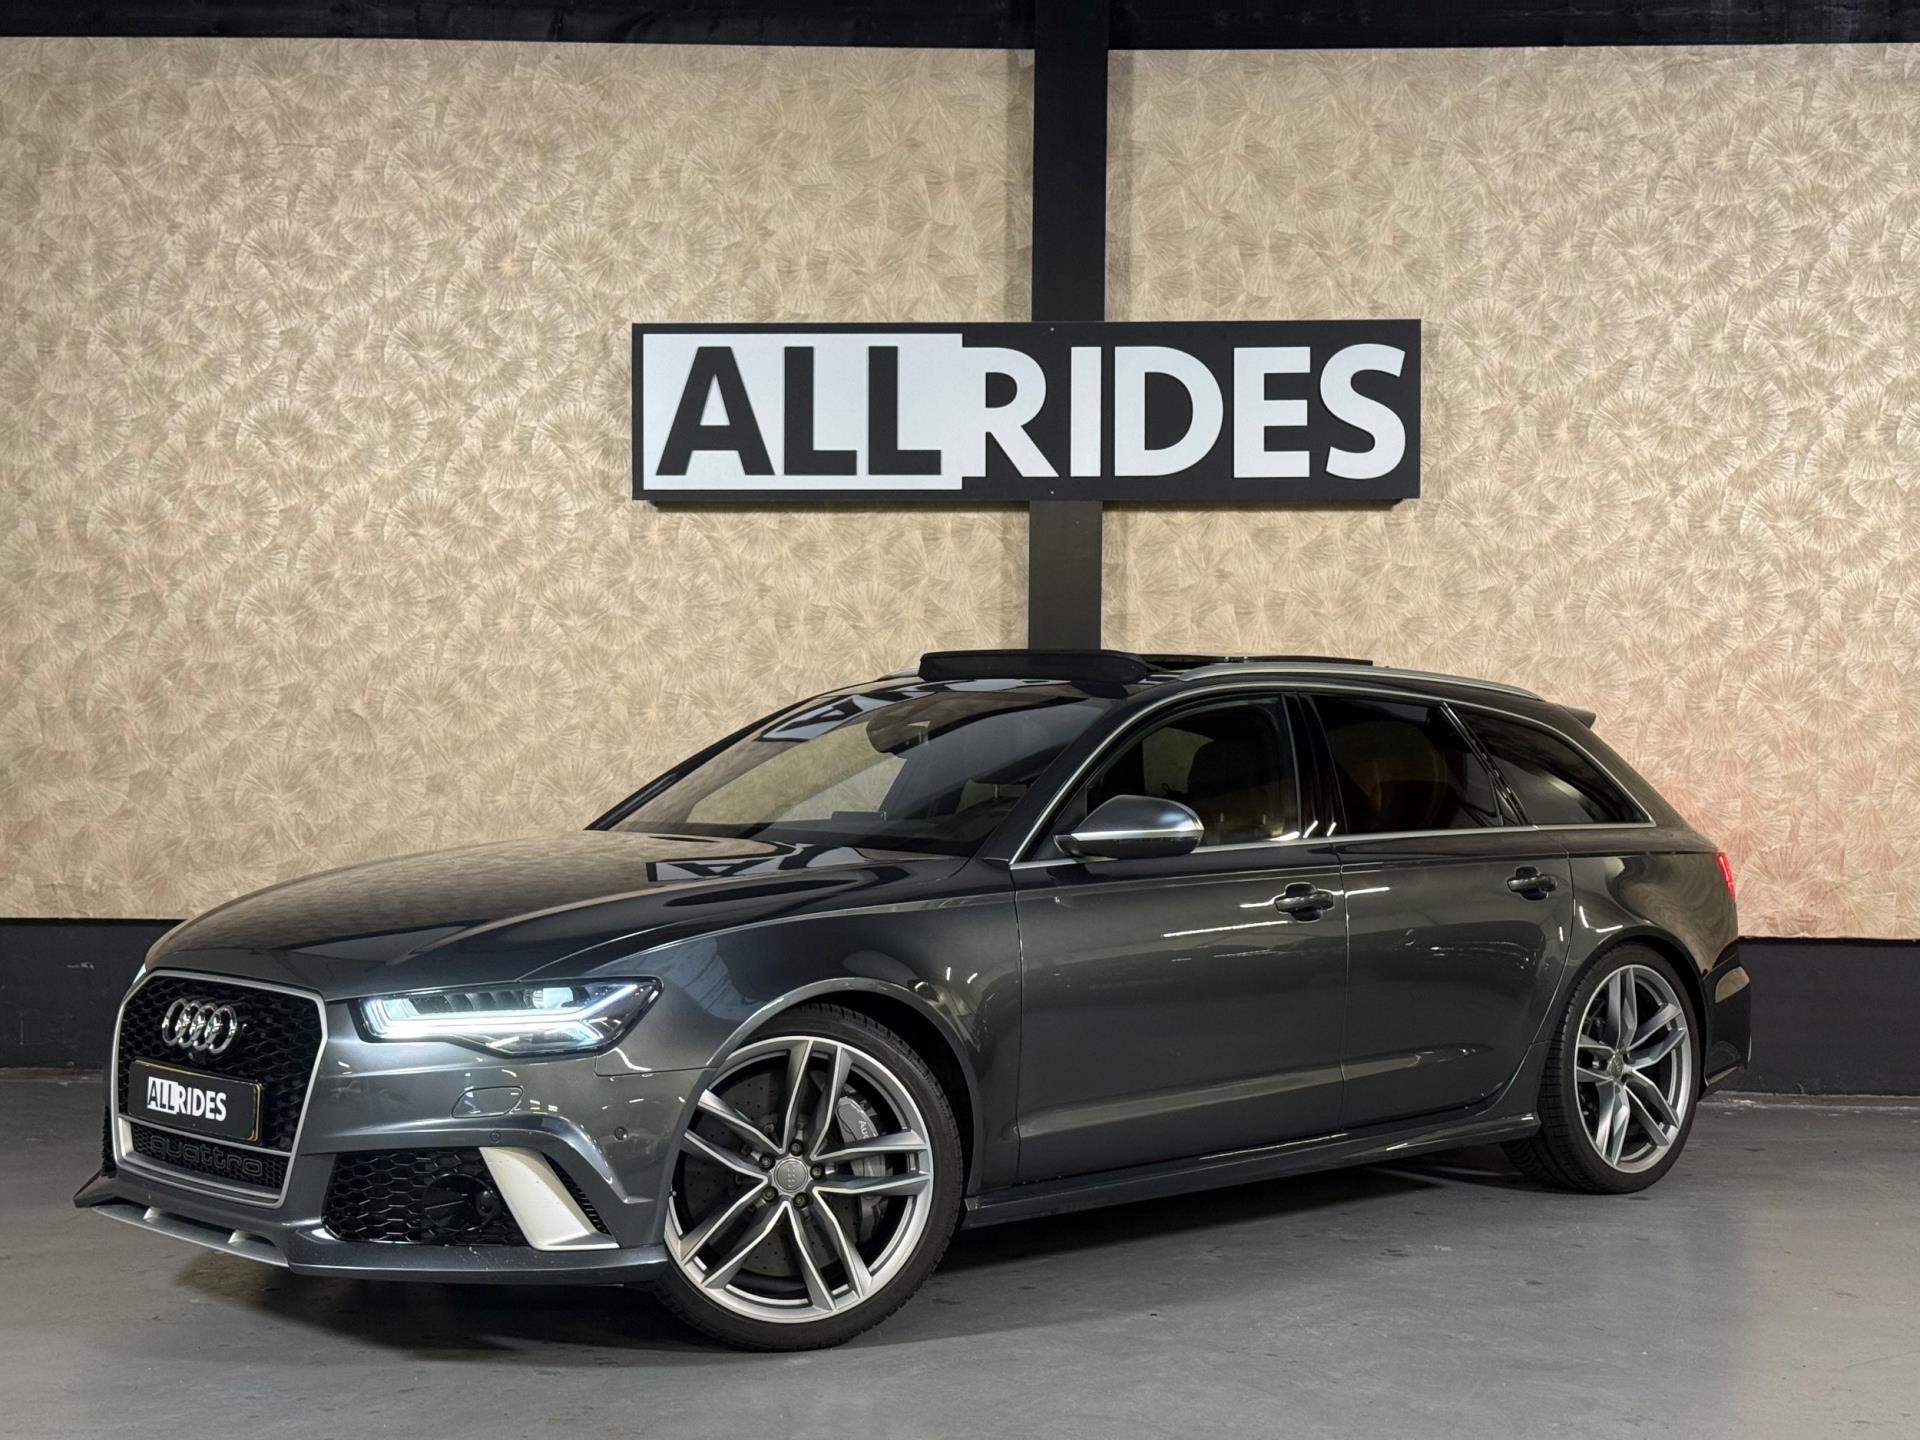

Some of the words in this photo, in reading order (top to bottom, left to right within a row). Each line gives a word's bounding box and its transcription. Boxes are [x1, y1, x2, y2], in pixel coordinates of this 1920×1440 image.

[655, 343, 1407, 479] ALLRIDES
[148, 1078, 227, 1122] ALLRIDES
[150, 1135, 262, 1177] quattro
